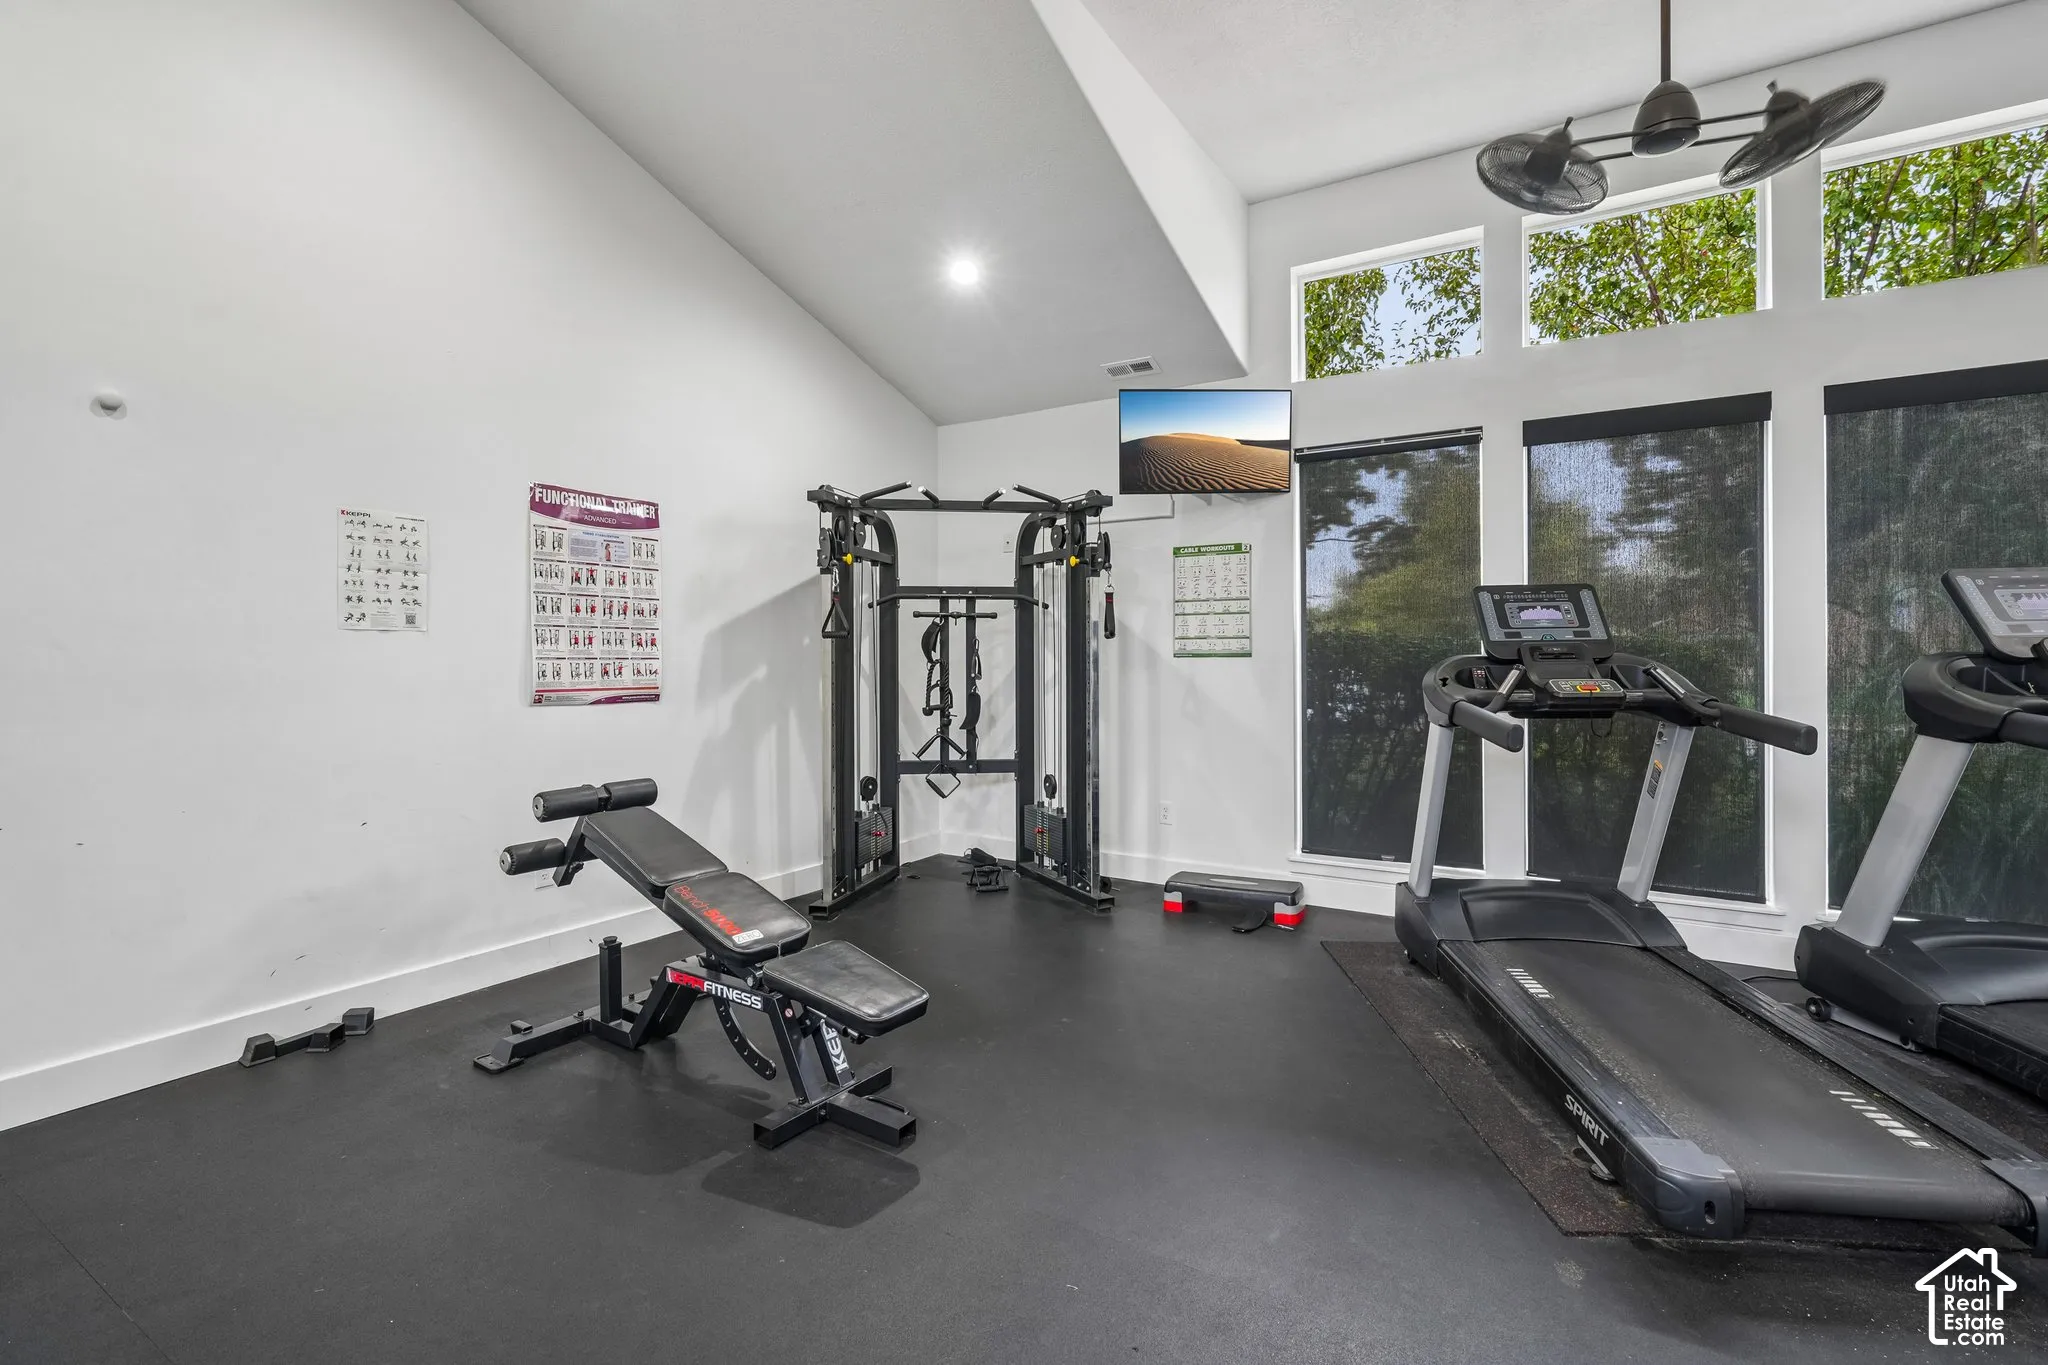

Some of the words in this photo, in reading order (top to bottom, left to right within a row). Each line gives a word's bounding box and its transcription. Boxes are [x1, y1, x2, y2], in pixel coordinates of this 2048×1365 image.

[535, 487, 608, 510] FUNCTIONAL
[612, 499, 656, 519] TRAINER
[584, 515, 617, 524] ADVANCED
[1564, 1094, 1609, 1146] SPIRIT
